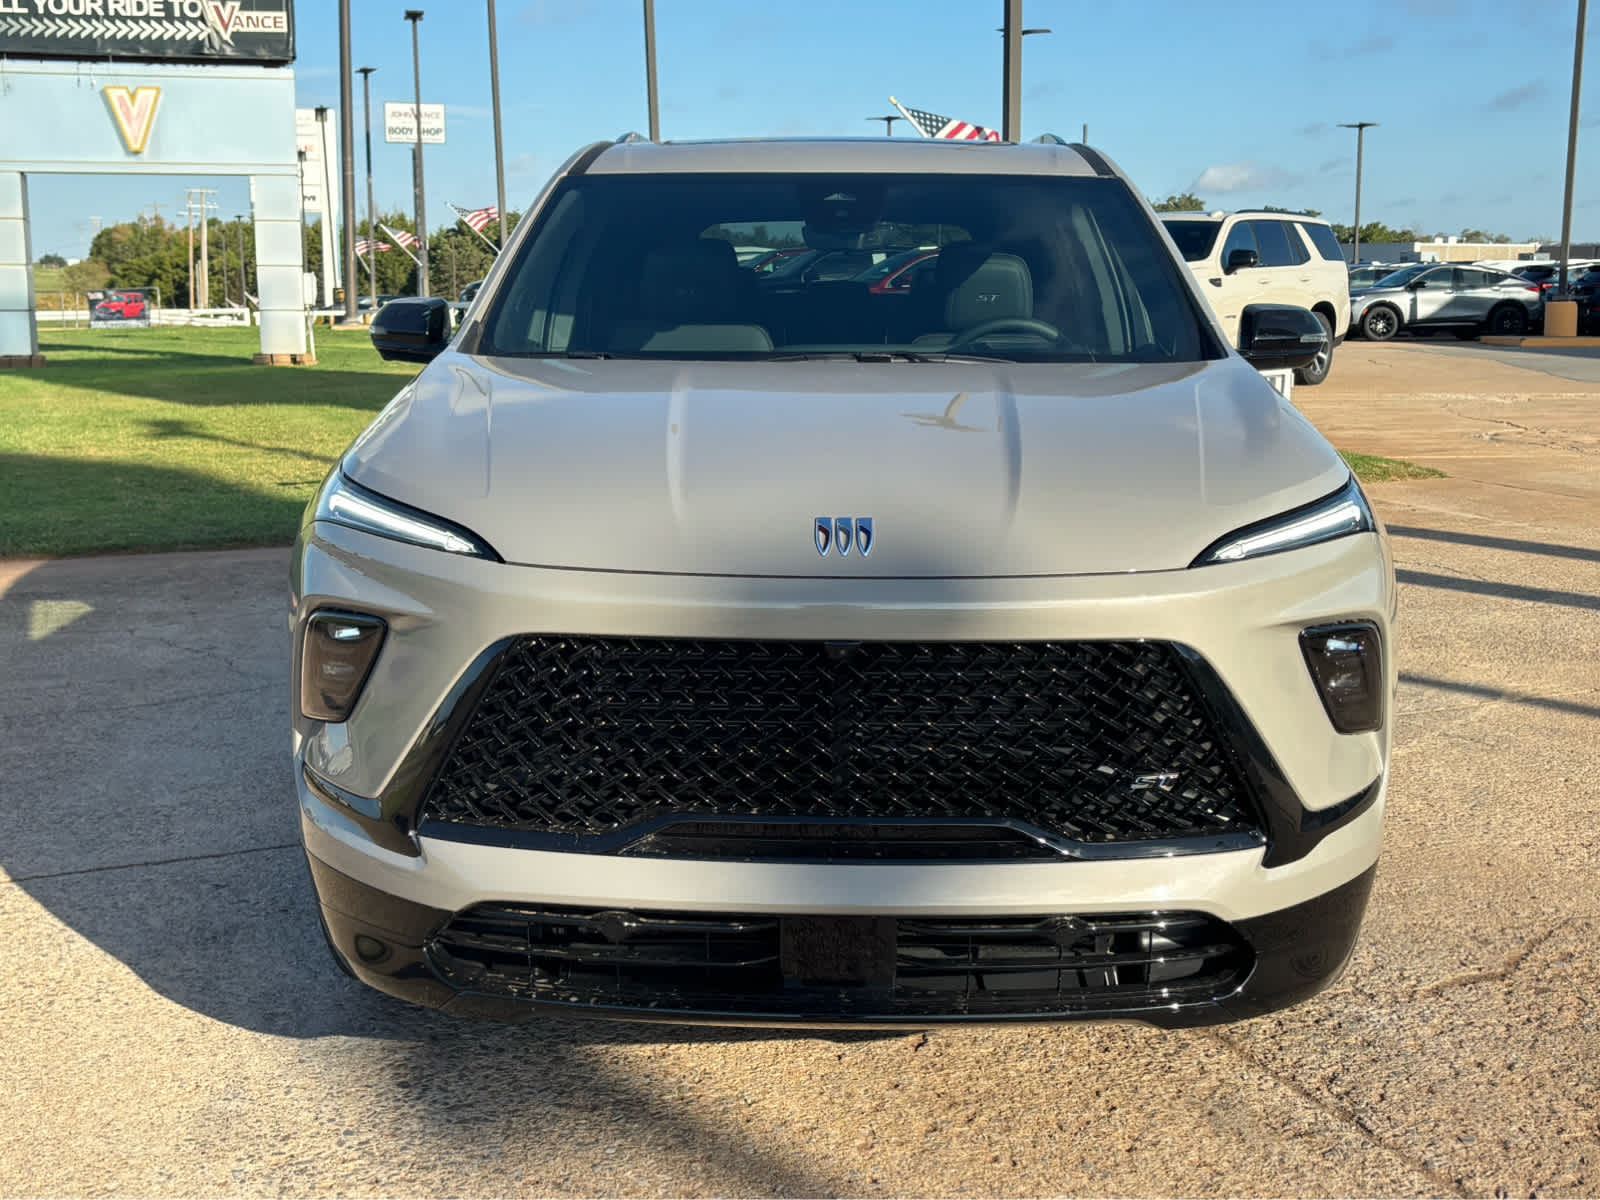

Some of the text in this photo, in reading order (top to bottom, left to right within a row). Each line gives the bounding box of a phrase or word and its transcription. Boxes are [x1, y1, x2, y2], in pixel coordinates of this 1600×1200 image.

[33, 0, 104, 16] YOUR
[108, 0, 166, 17] RIDE
[168, 0, 202, 18] TO
[210, 3, 284, 35] VANCE
[104, 86, 161, 152] V
[388, 126, 443, 137] BODY HOP
